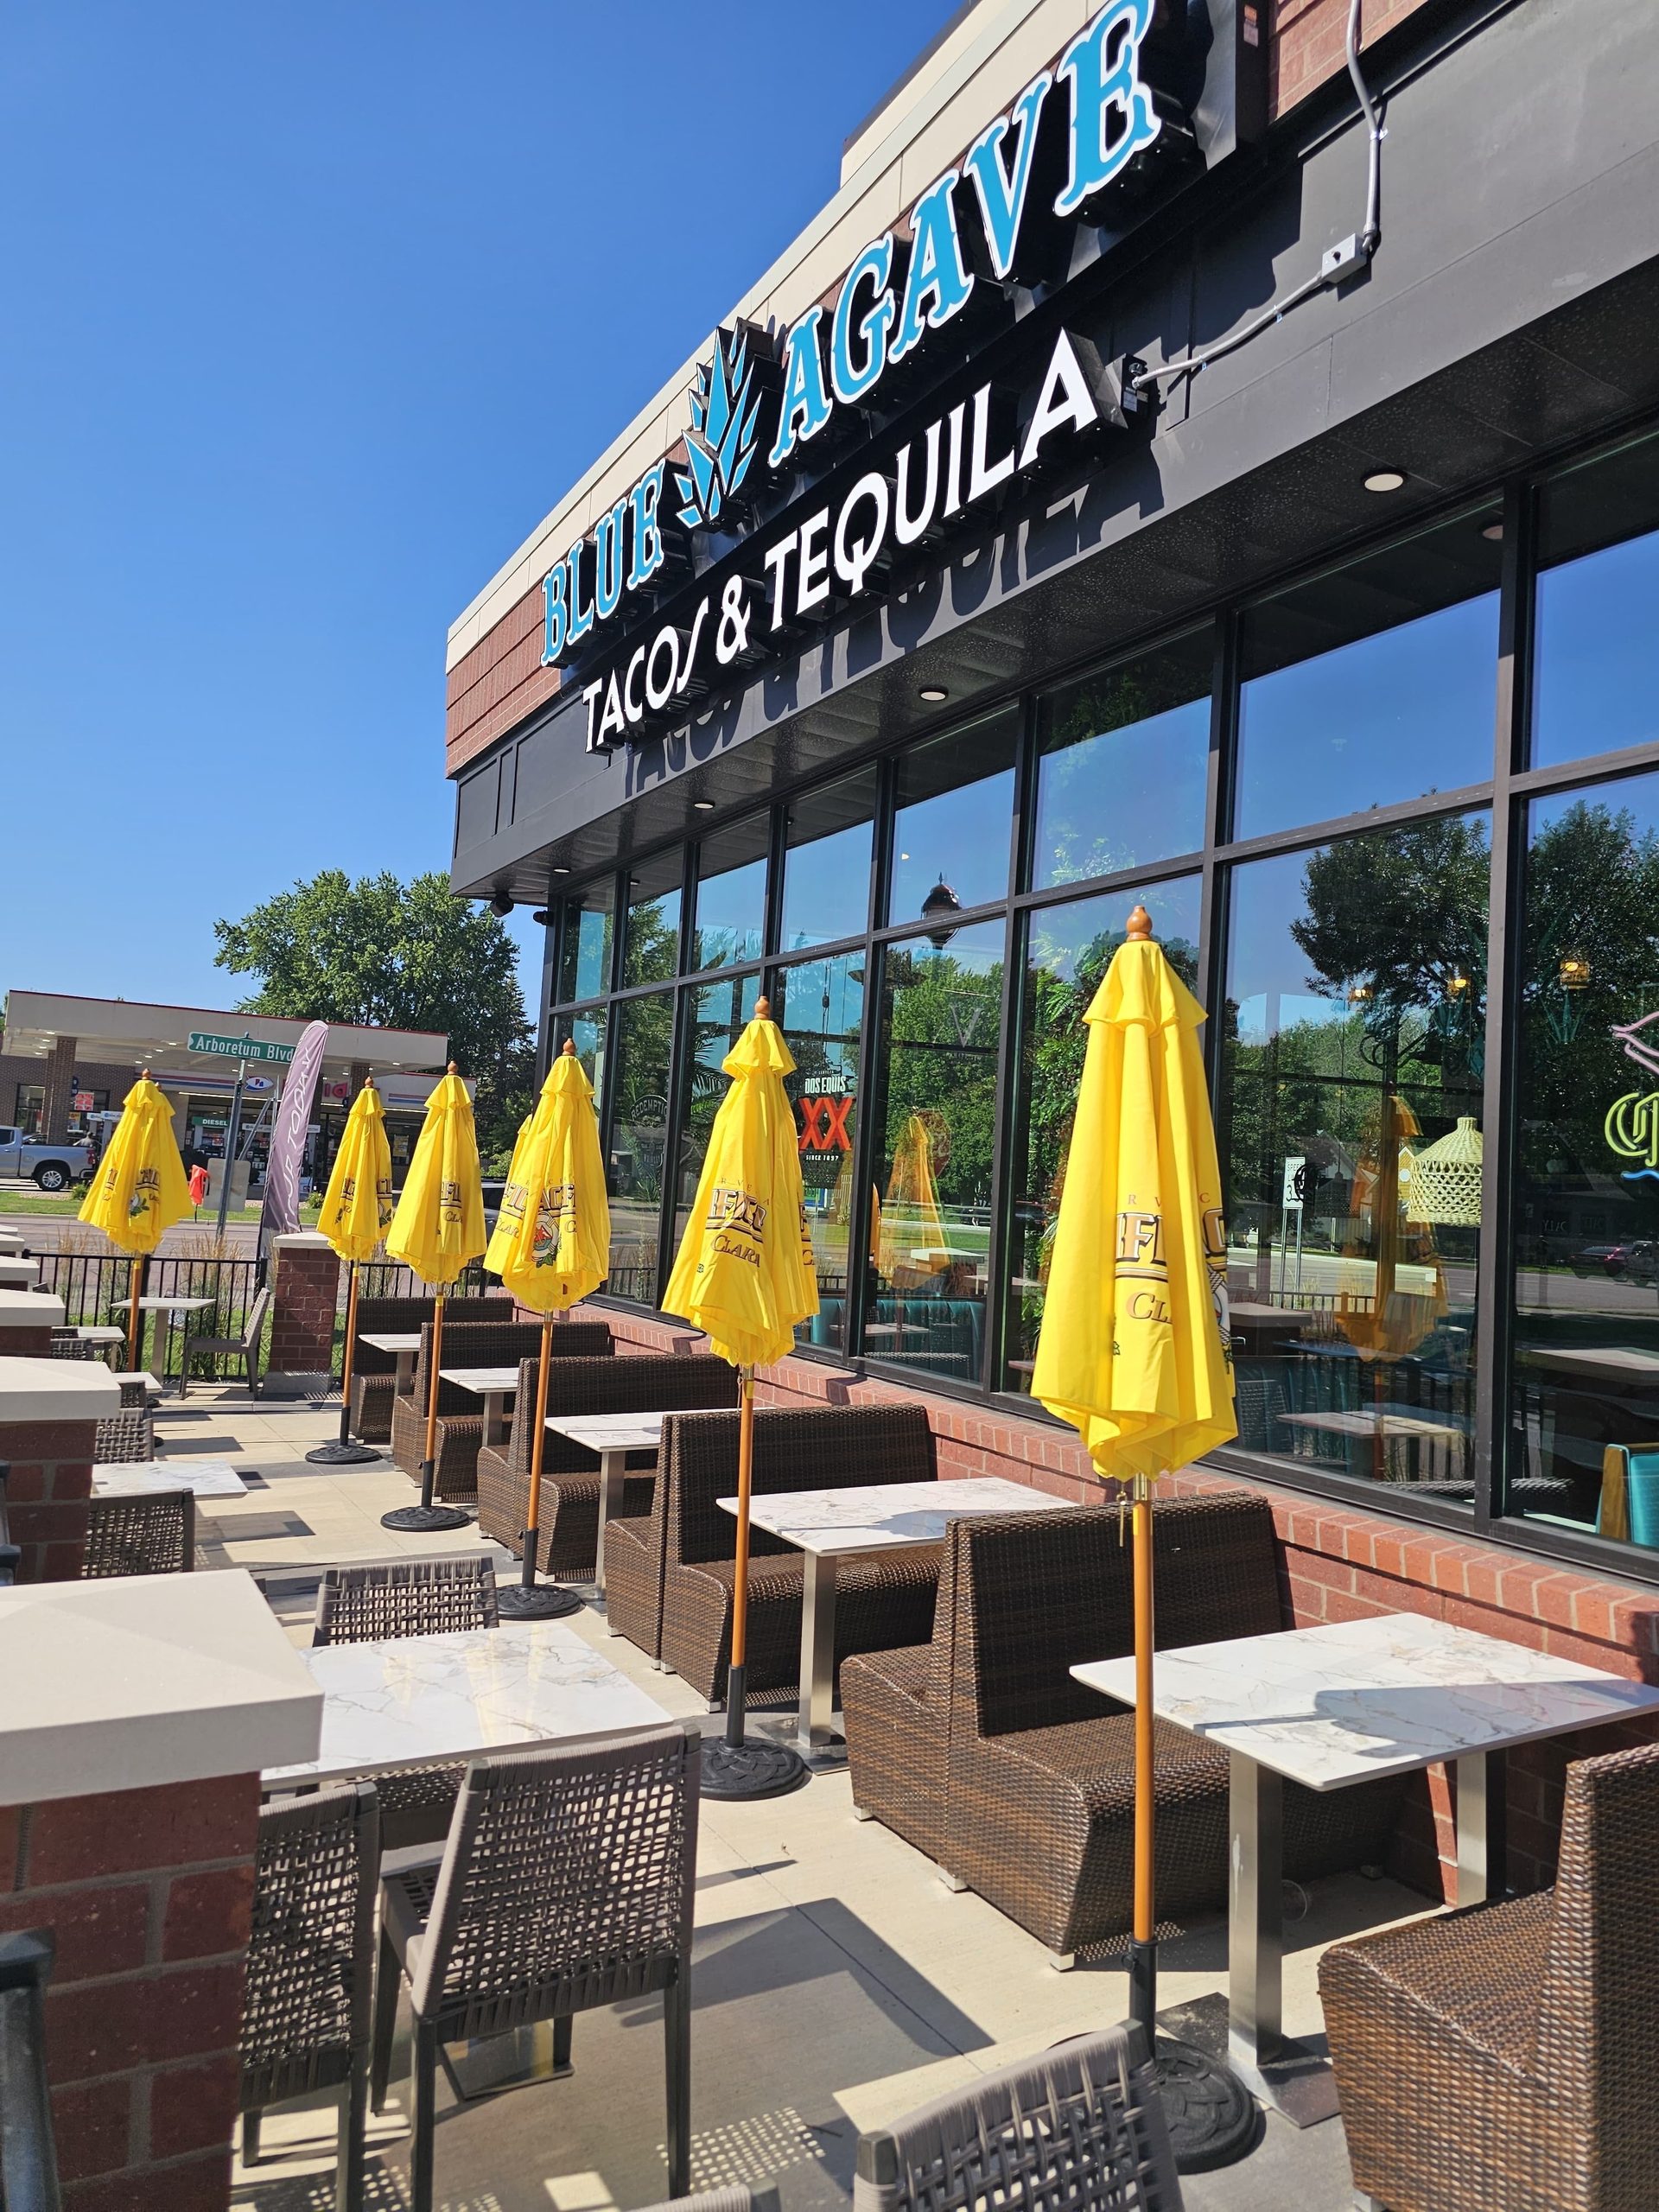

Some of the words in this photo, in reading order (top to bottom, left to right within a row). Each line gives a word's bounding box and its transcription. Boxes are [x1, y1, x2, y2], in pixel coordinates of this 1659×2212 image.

[541, 457, 666, 667] BLUE
[767, 0, 1162, 467] AGAVE
[582, 596, 709, 753] TACOS
[715, 574, 752, 664] &
[763, 327, 1099, 632] TEQUILA
[195, 1036, 261, 1058] Arboretum
[267, 1045, 293, 1062] Blvd
[804, 1077, 821, 1094] DOS
[821, 1076, 847, 1094] EQUIS
[287, 1046, 312, 1149] TODAY
[798, 1096, 853, 1151] XX
